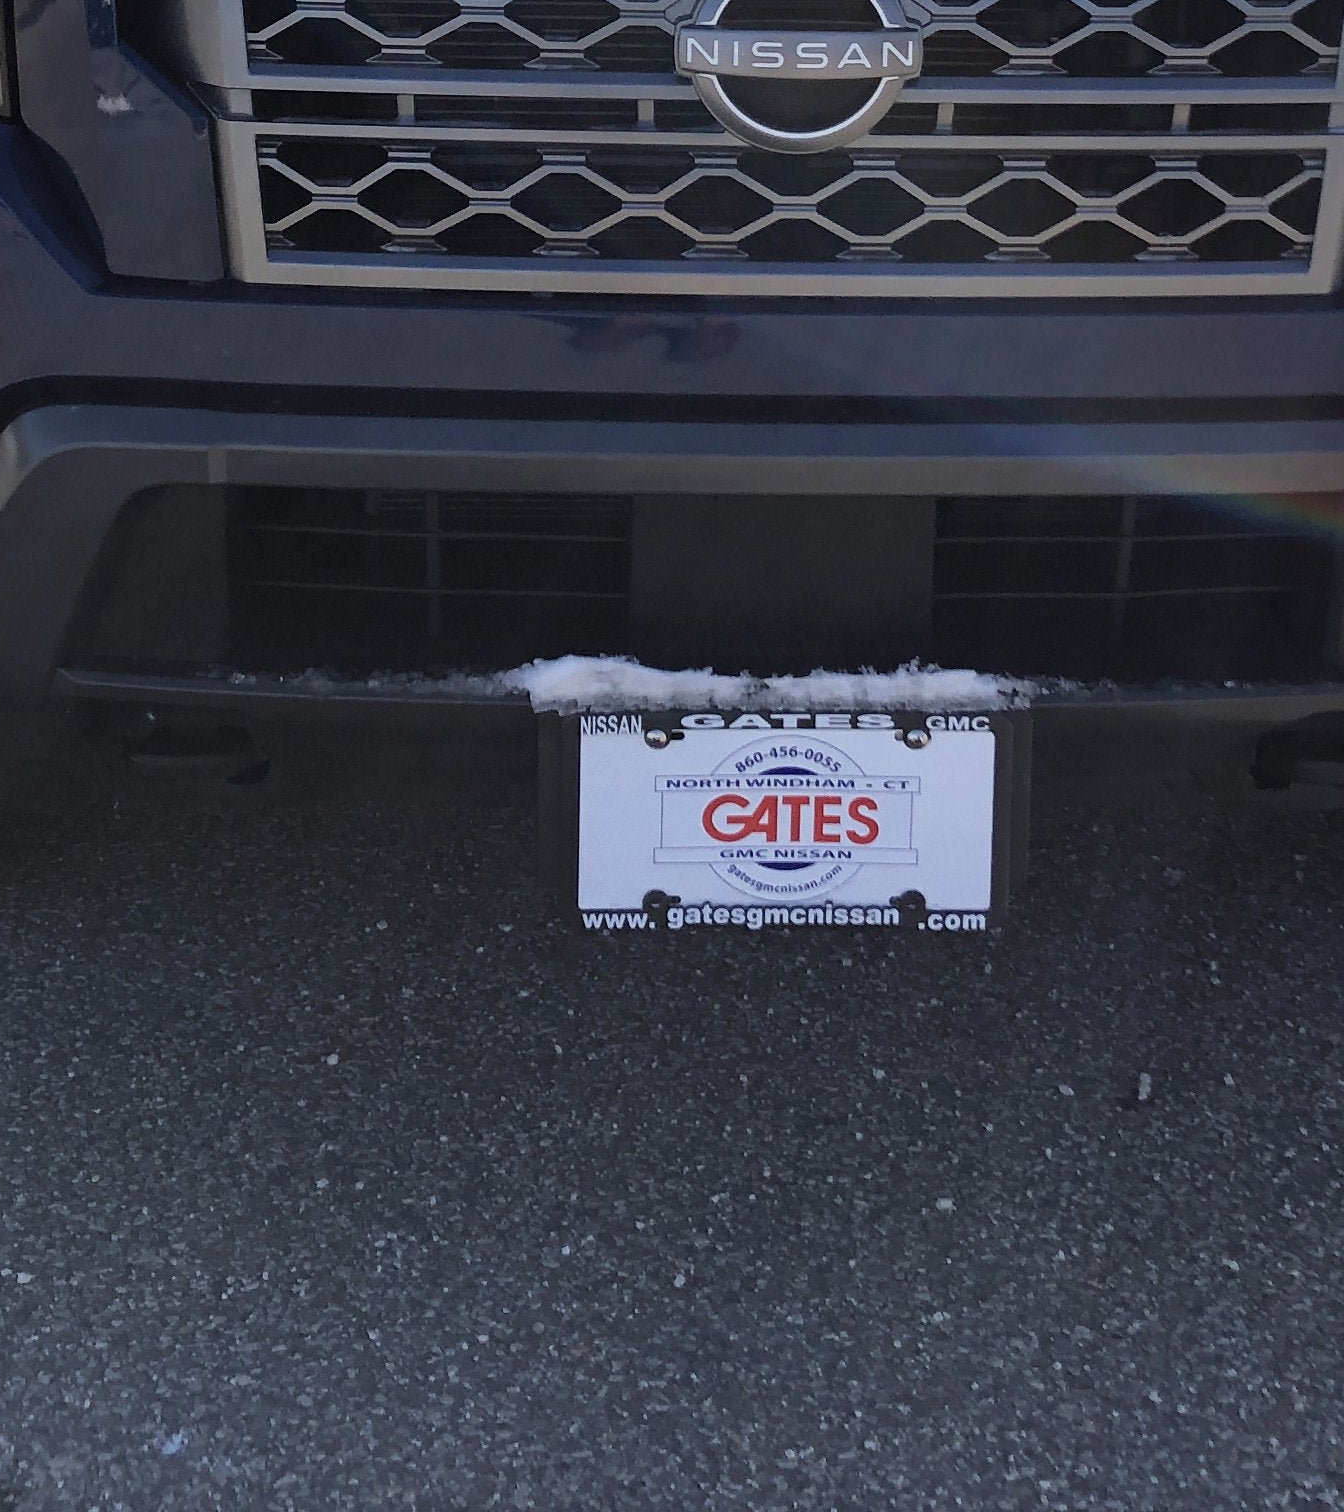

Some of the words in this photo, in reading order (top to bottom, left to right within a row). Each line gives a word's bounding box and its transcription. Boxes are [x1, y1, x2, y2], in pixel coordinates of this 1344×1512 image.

[686, 38, 913, 69] NISSAN
[580, 714, 643, 736] NISSAN
[680, 713, 895, 729] GATES
[925, 715, 990, 731] GMC
[735, 745, 842, 774] 860-456-0055
[666, 779, 740, 788] NORTH
[746, 779, 856, 788] WINDHAM
[884, 780, 910, 789] CT
[702, 794, 879, 845] GATES
[720, 849, 767, 858] GMC
[774, 849, 852, 859] NISSAN
[727, 864, 843, 894] gatesgmcnissan.com
[582, 912, 656, 929] www.
[667, 904, 900, 930] gatesgmcnissan
[918, 913, 986, 931] .com
